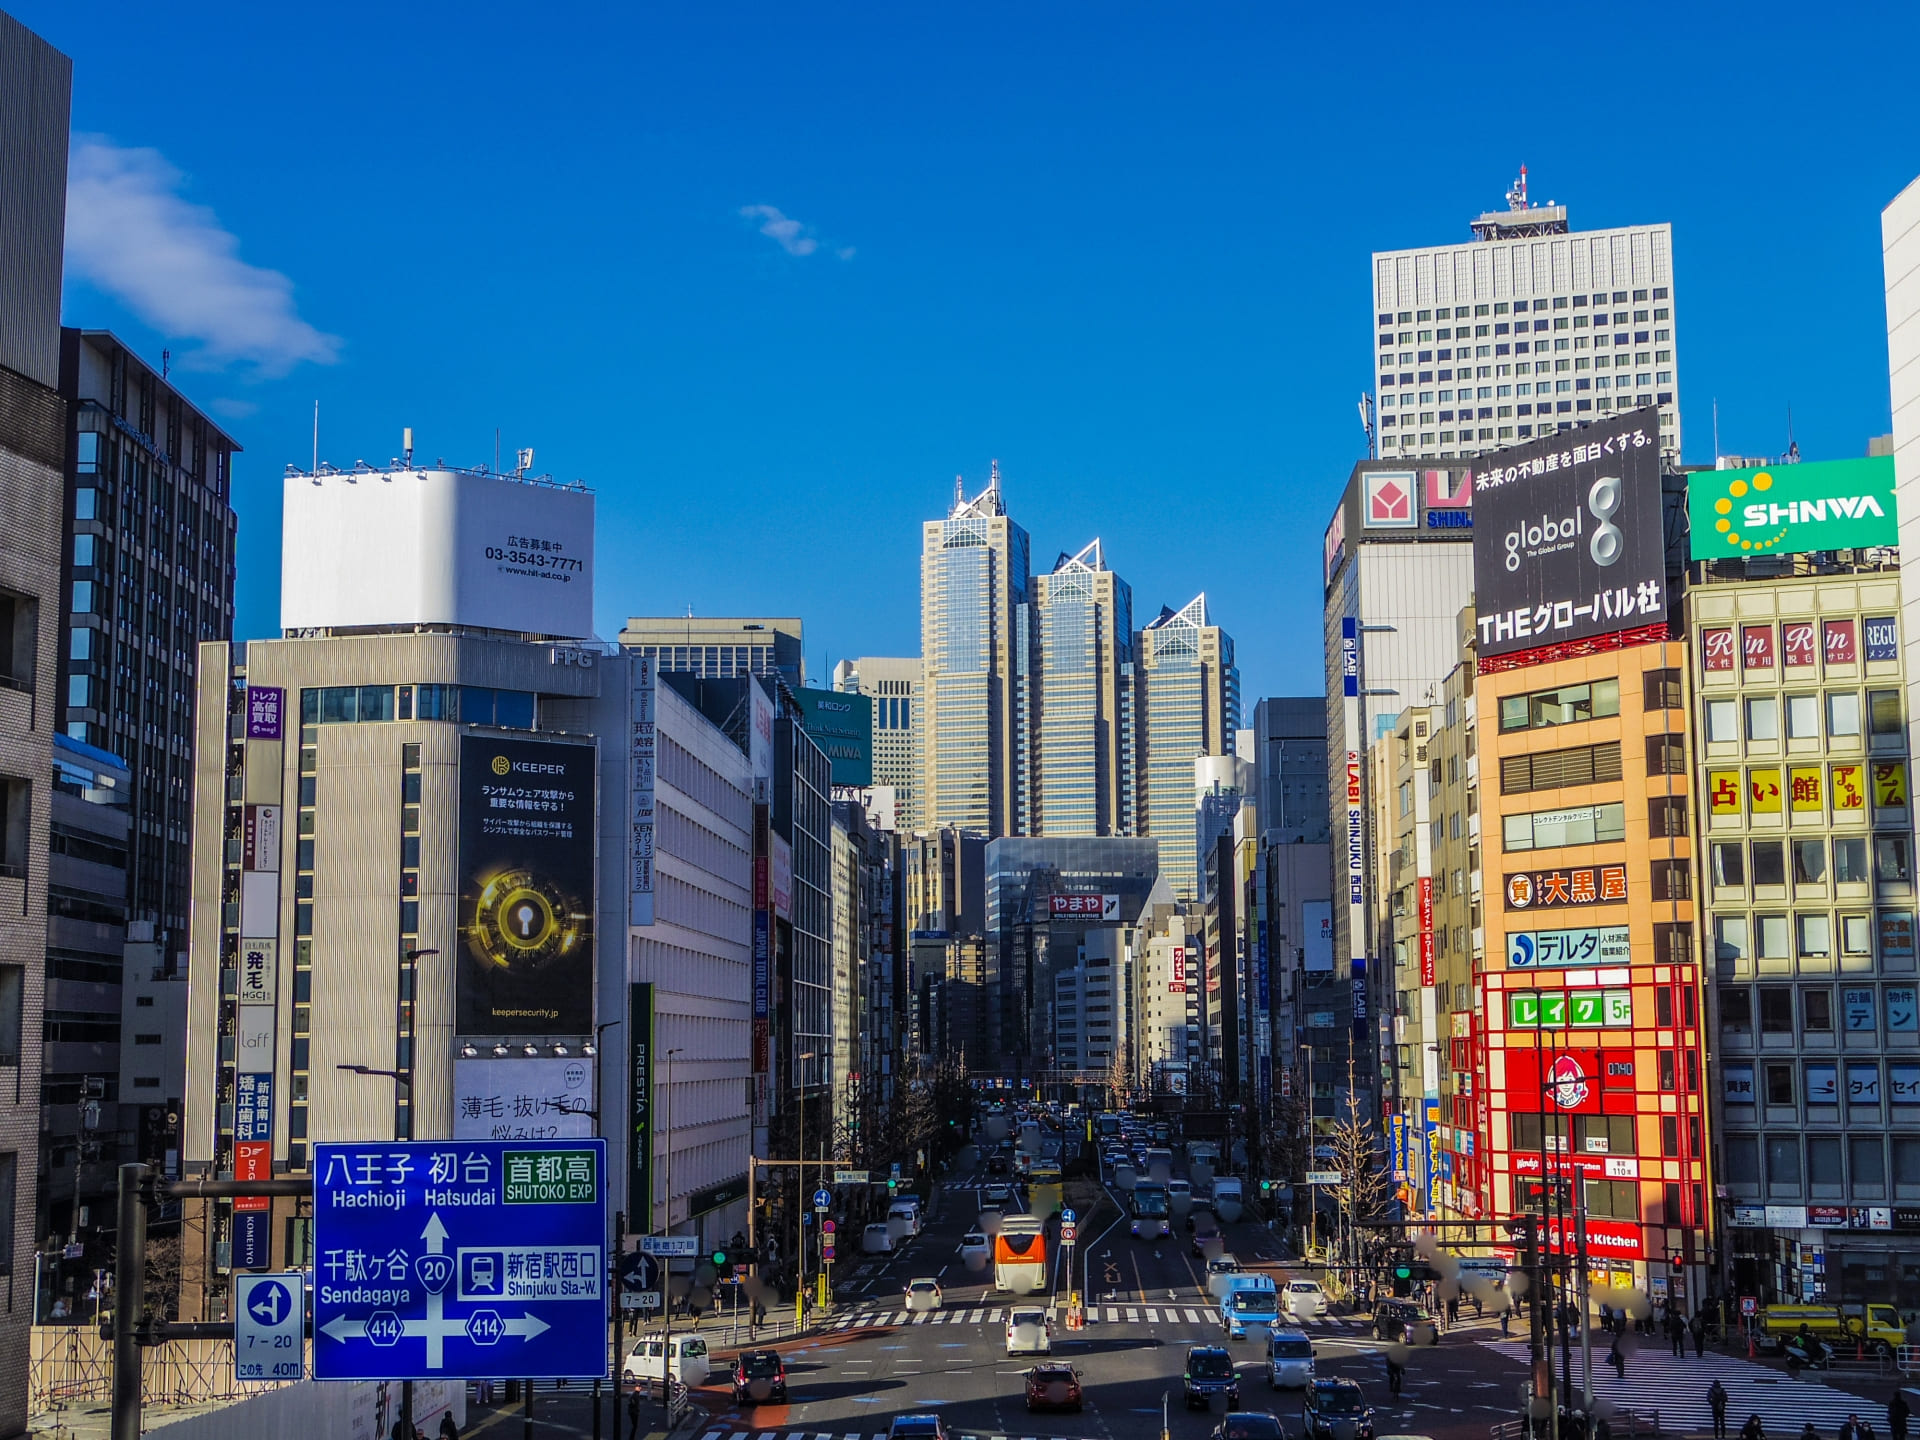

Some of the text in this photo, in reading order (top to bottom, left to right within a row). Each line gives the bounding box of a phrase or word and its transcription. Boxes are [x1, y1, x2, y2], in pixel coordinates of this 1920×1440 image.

[1476, 429, 1651, 492] 未来の不動産を面白くする。
[1743, 495, 1885, 527] SHINWA
[508, 535, 563, 554] 広告募集中
[1505, 506, 1582, 572] global
[1538, 545, 1556, 556] Global
[1557, 541, 1575, 552] Group
[485, 547, 583, 572] 03-3543-7771
[1477, 580, 1661, 645] THEグローバル社
[551, 648, 593, 668] FPG
[1348, 651, 1357, 676] LABI
[252, 702, 277, 713] 高価
[253, 691, 277, 701] トレカ
[252, 713, 277, 724] 買取
[828, 744, 862, 760] MIWA
[513, 762, 564, 775] KEEPER
[482, 785, 575, 800] ランサムウェア攻撃から
[1347, 763, 1360, 804] LABI
[1349, 810, 1361, 869] SHINJUKU
[1544, 867, 1626, 905] 大黒屋
[1053, 897, 1099, 911] やまや
[755, 928, 767, 957] JAPAN
[1539, 933, 1599, 961] デルタ
[247, 952, 264, 989] 発毛
[755, 960, 767, 987] TOTAL
[492, 1007, 559, 1018] keepersecurity.jp
[755, 989, 766, 1013] CLUB
[1357, 992, 1366, 1018] LABI
[1523, 1001, 1594, 1021] レイク
[1613, 1000, 1630, 1019] 5F
[237, 1076, 255, 1139] 矯正歯科
[257, 1081, 271, 1133] 新宿南口
[462, 1094, 587, 1119] 薄毛・抜け毛の
[324, 1152, 492, 1185] 八王子 初台
[508, 1155, 591, 1183] 首都高
[332, 1188, 496, 1210] Hachioji Hatsudai
[507, 1184, 593, 1200] SHUTOKO EXP
[246, 1216, 254, 1265] KOMEHYO
[1594, 1233, 1639, 1248] Kitchen
[424, 1262, 446, 1281] 20
[507, 1252, 596, 1279] 新宿駅西口
[321, 1286, 410, 1306] Sendagaya
[508, 1280, 597, 1298] Shinjuku Sta.-W.
[371, 1318, 498, 1337] 414 414
[240, 1362, 299, 1376] この先 40m
